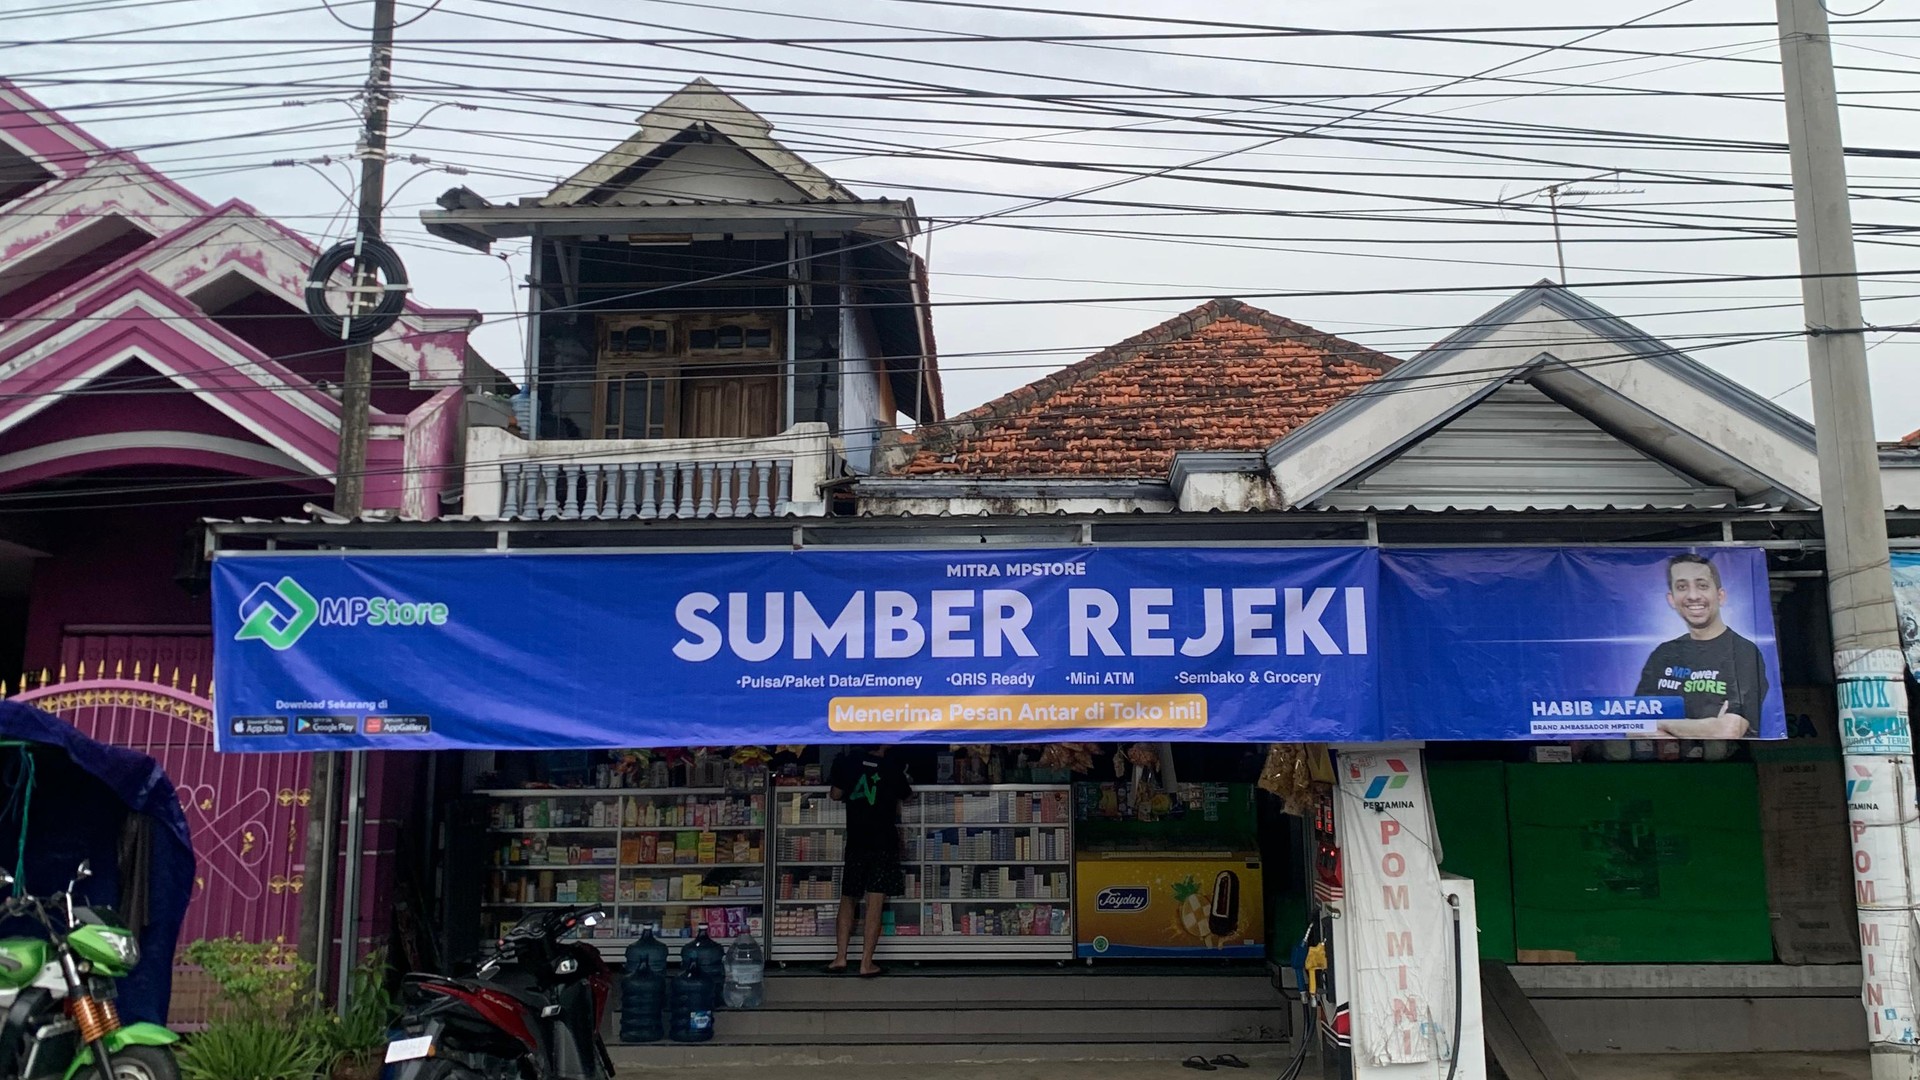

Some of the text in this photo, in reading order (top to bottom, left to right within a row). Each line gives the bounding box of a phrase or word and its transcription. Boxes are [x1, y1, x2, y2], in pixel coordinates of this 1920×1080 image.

[946, 562, 1086, 577] MITRA MPSTORE
[319, 597, 449, 626] MPStore
[672, 587, 1368, 662] SUMBER REJEKI
[992, 672, 1036, 688] Ready
[1103, 671, 1135, 685] ATM
[1249, 671, 1260, 684] &
[1263, 670, 1322, 686] Grocery
[1664, 666, 1720, 681] eMPower
[829, 674, 923, 689] Data/Emoney
[1683, 680, 1727, 695] STORE
[275, 700, 388, 712] Download Sekarang di
[835, 701, 1201, 723] Menerima Pesan Antar di Toko ini!
[1532, 700, 1664, 717] HABIB JAFAR
[246, 724, 286, 734] App Store
[312, 723, 354, 733] Google Play
[383, 723, 428, 733] AppGallery
[1532, 723, 1558, 731] BRAND
[1560, 723, 1610, 731] AMBASSADOR
[1363, 801, 1415, 812] PERTAMINA
[1100, 890, 1145, 908] Joyday
